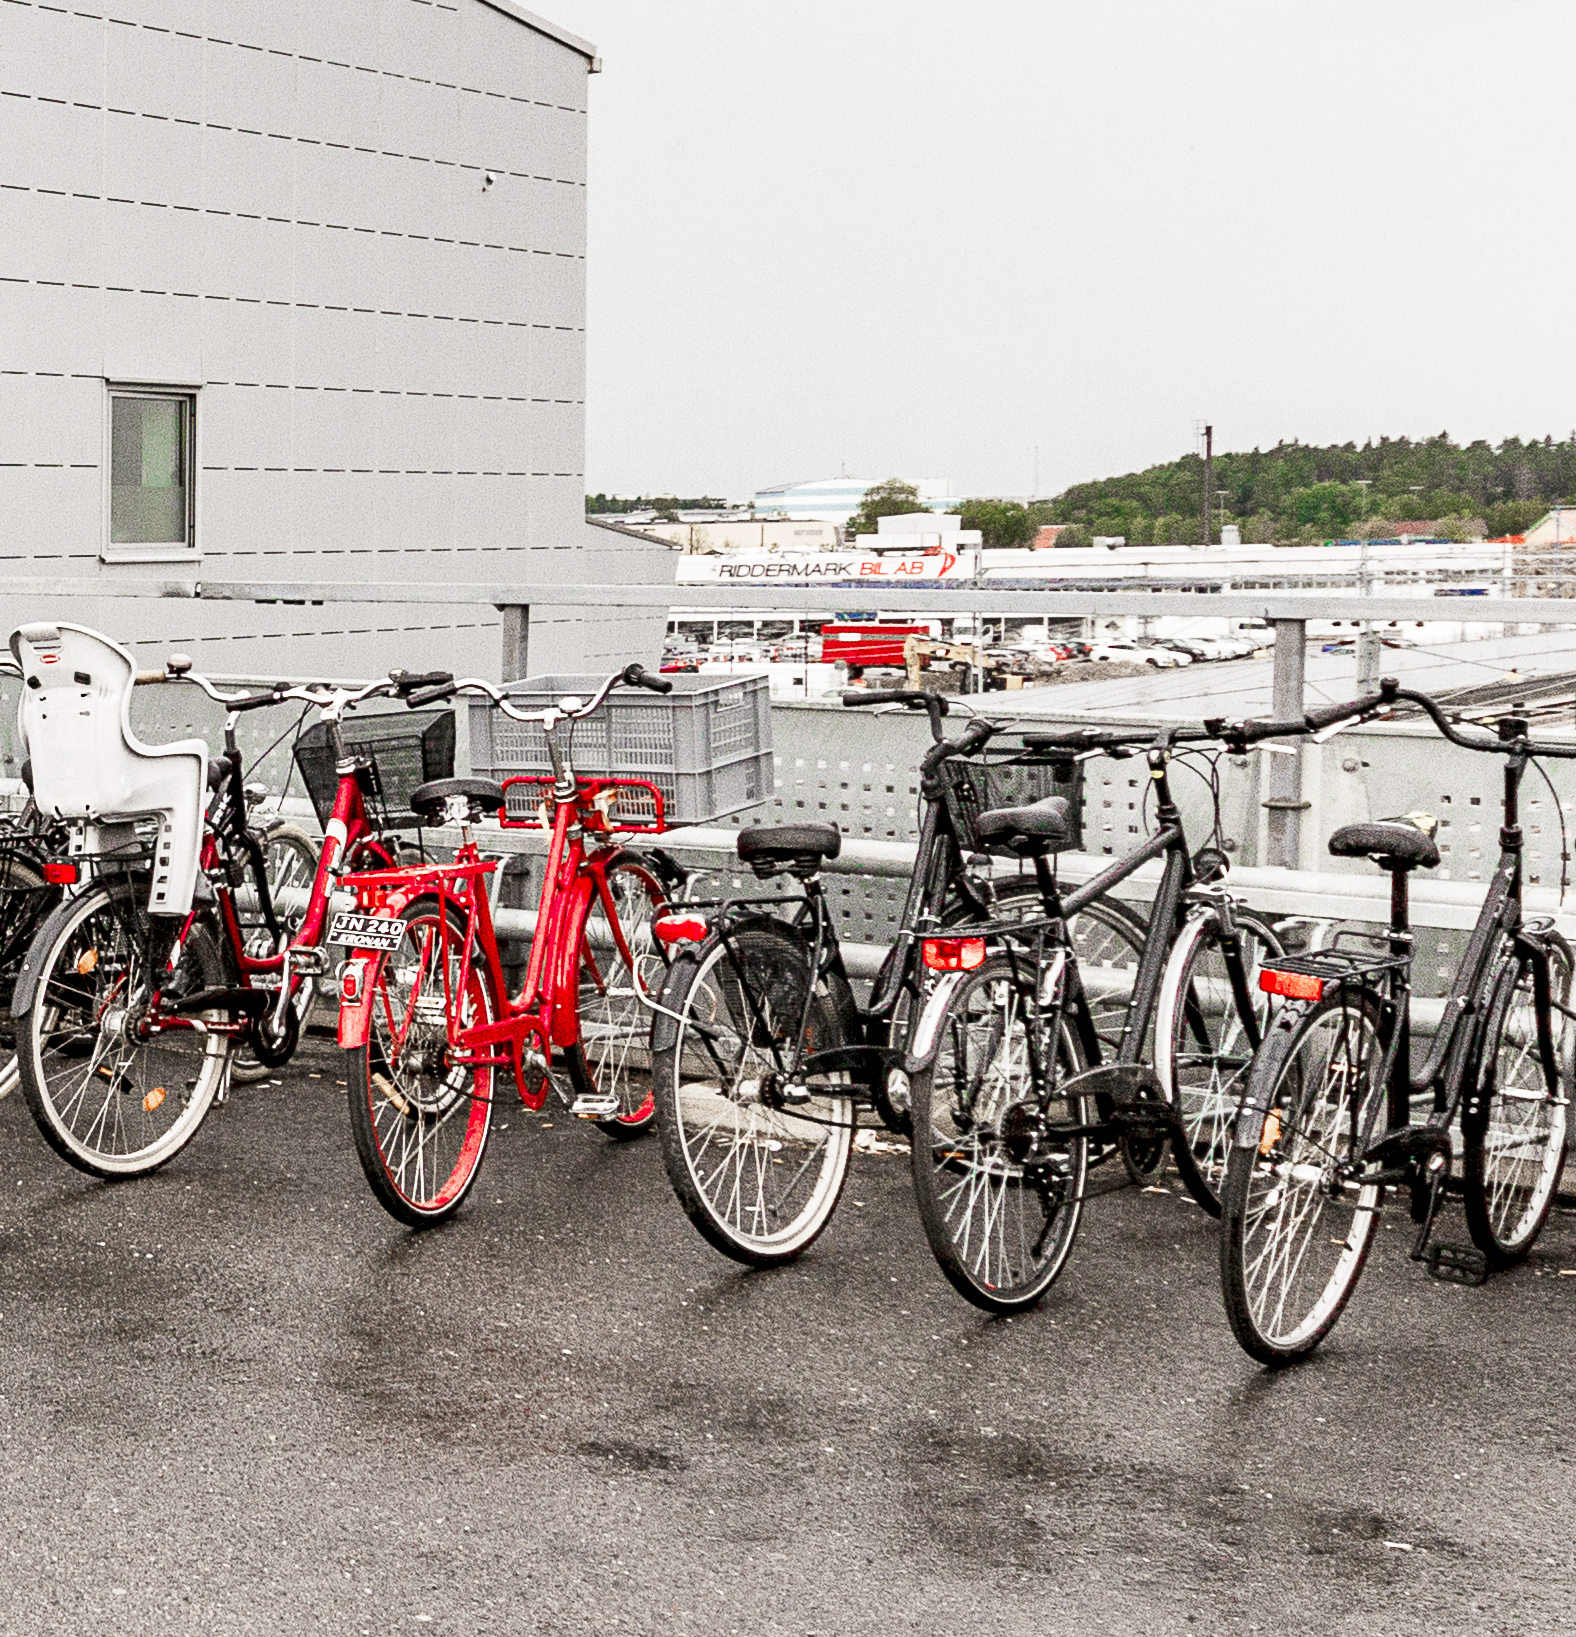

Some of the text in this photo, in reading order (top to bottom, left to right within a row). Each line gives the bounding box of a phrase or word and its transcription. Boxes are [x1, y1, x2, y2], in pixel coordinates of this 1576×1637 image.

[719, 561, 925, 578] RIDDERMARK BIL AB
[335, 916, 403, 935] JN 240
[338, 933, 391, 947] KRONAN
